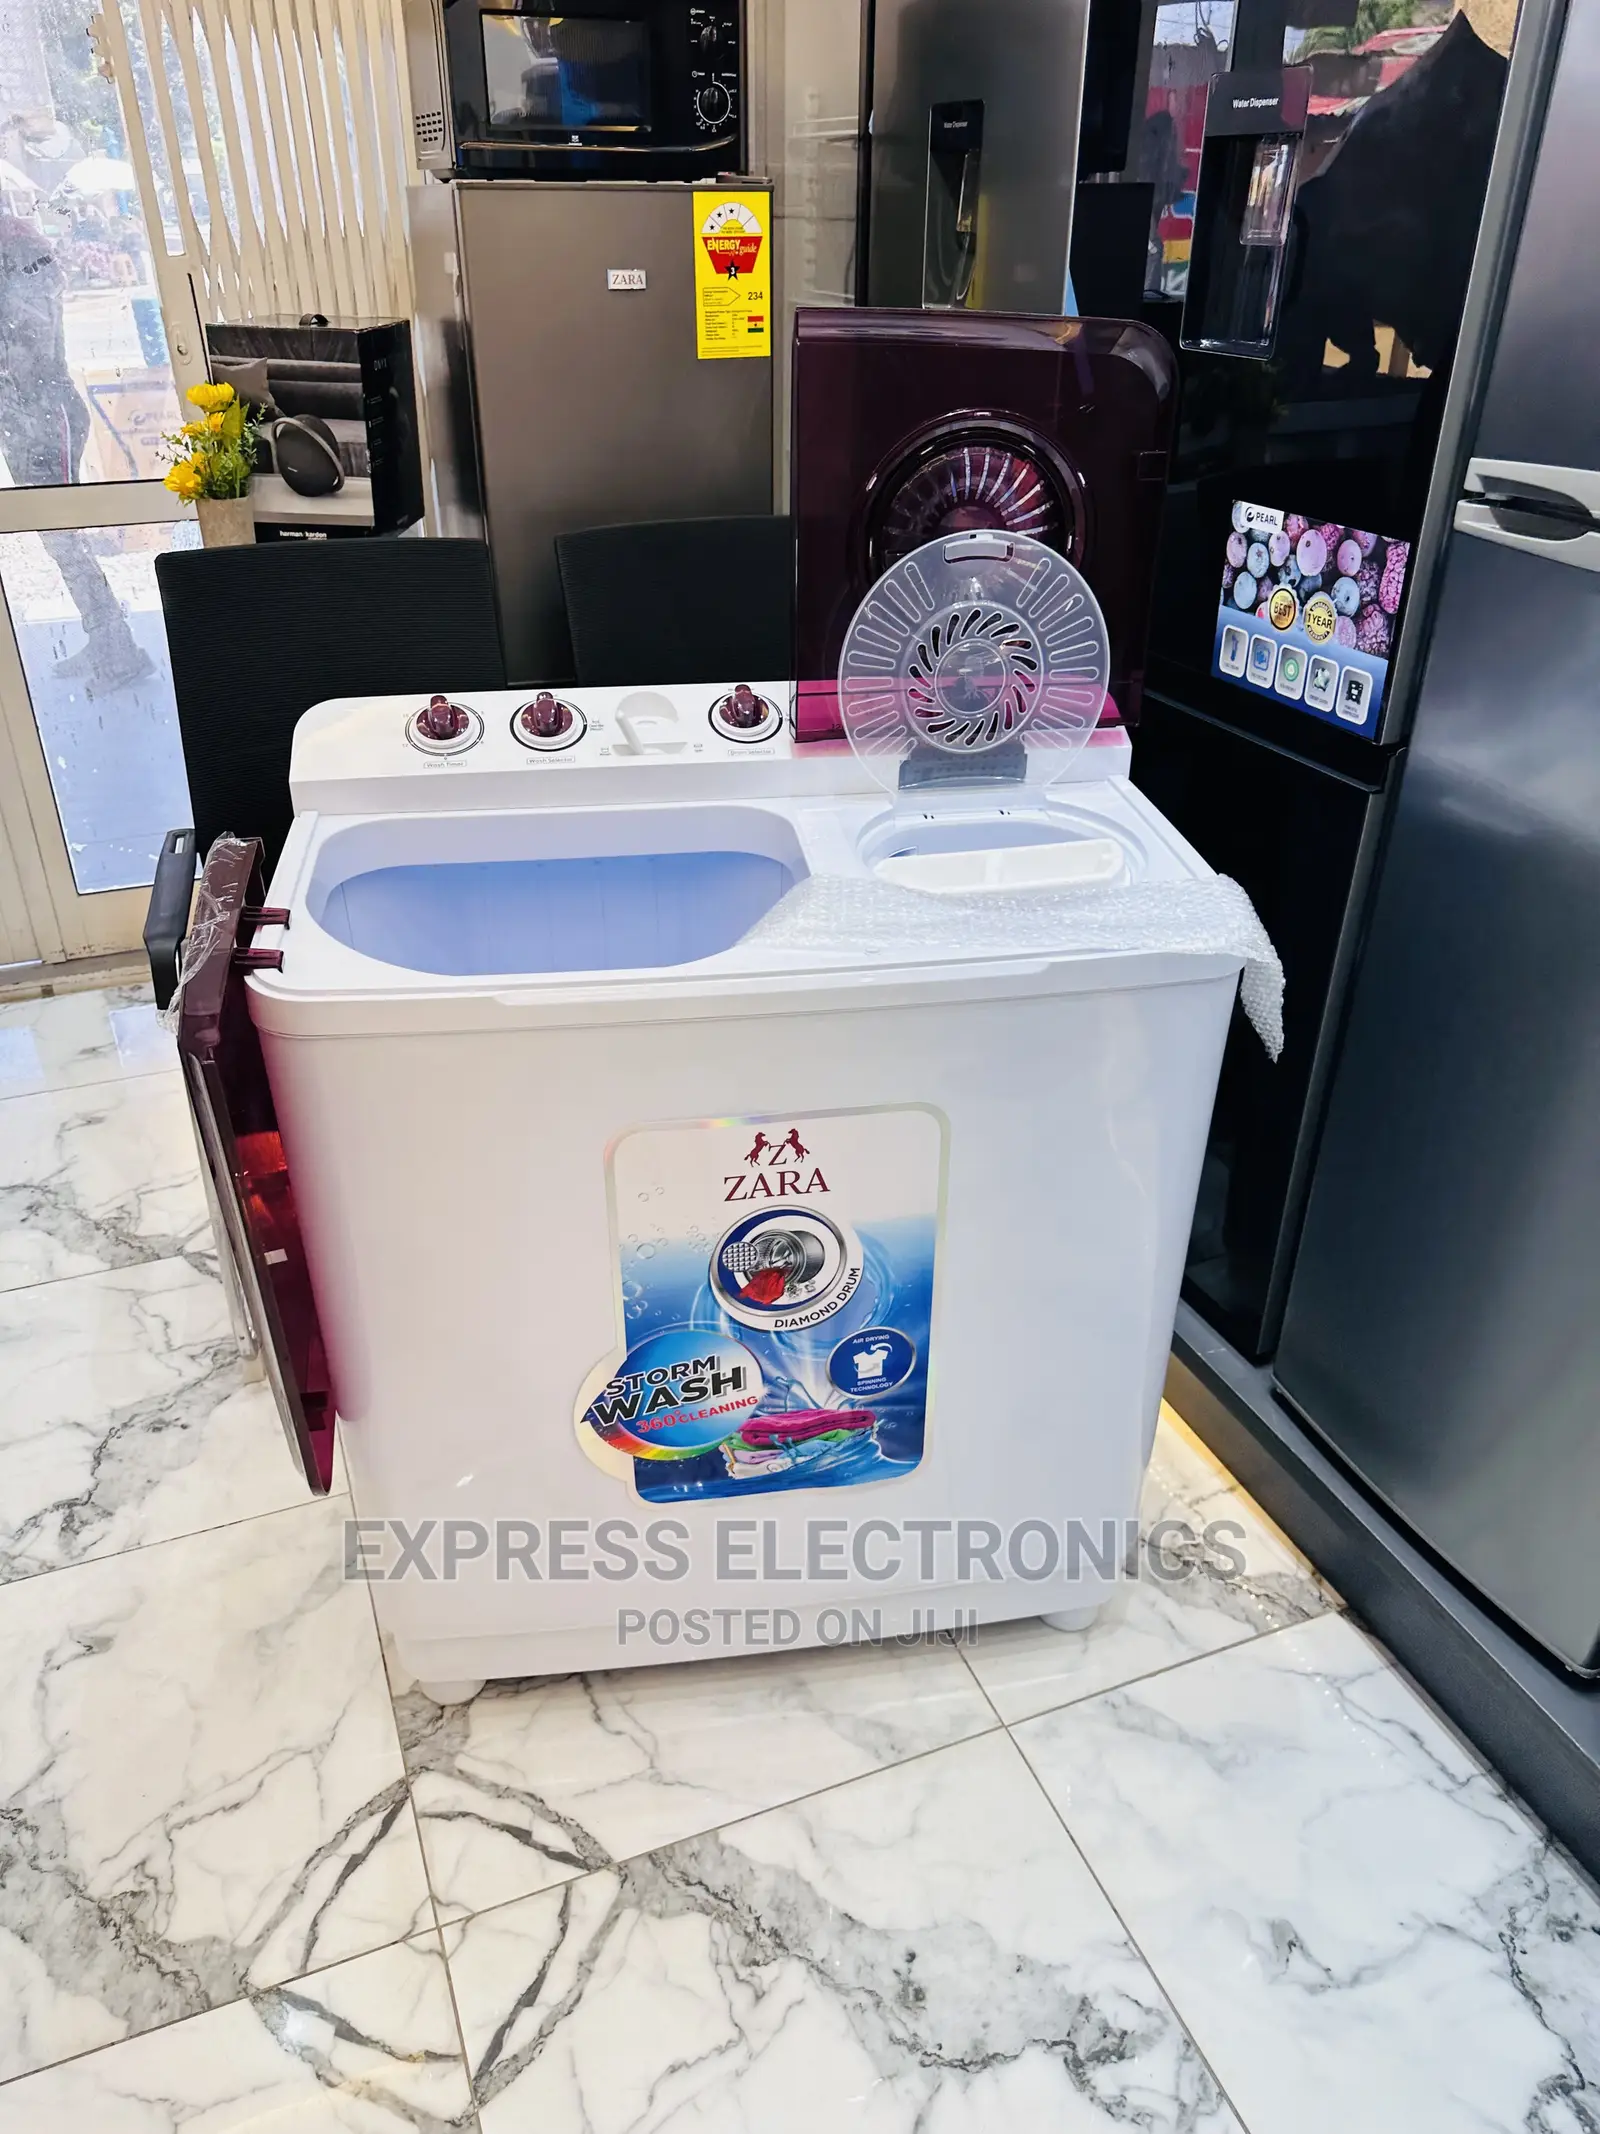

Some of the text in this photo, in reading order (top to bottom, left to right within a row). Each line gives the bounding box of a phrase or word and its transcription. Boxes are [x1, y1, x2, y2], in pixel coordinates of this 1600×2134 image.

[706, 238, 741, 254] ENERGY
[730, 266, 736, 275] 3
[612, 273, 644, 286] ZARA
[747, 291, 763, 301] 234
[1255, 511, 1278, 526] PEARL
[1274, 601, 1292, 618] BEST
[1312, 614, 1333, 630] YEAR
[768, 1144, 787, 1166] Z
[723, 1167, 831, 1202] ZARA
[774, 1267, 861, 1329] DIAMOND DRUM
[865, 1334, 890, 1343] DRYING
[605, 1354, 717, 1397] STORM
[857, 1377, 887, 1387] SPINNING
[850, 1381, 893, 1393] TECHNOLOGY
[592, 1366, 746, 1427] WASH
